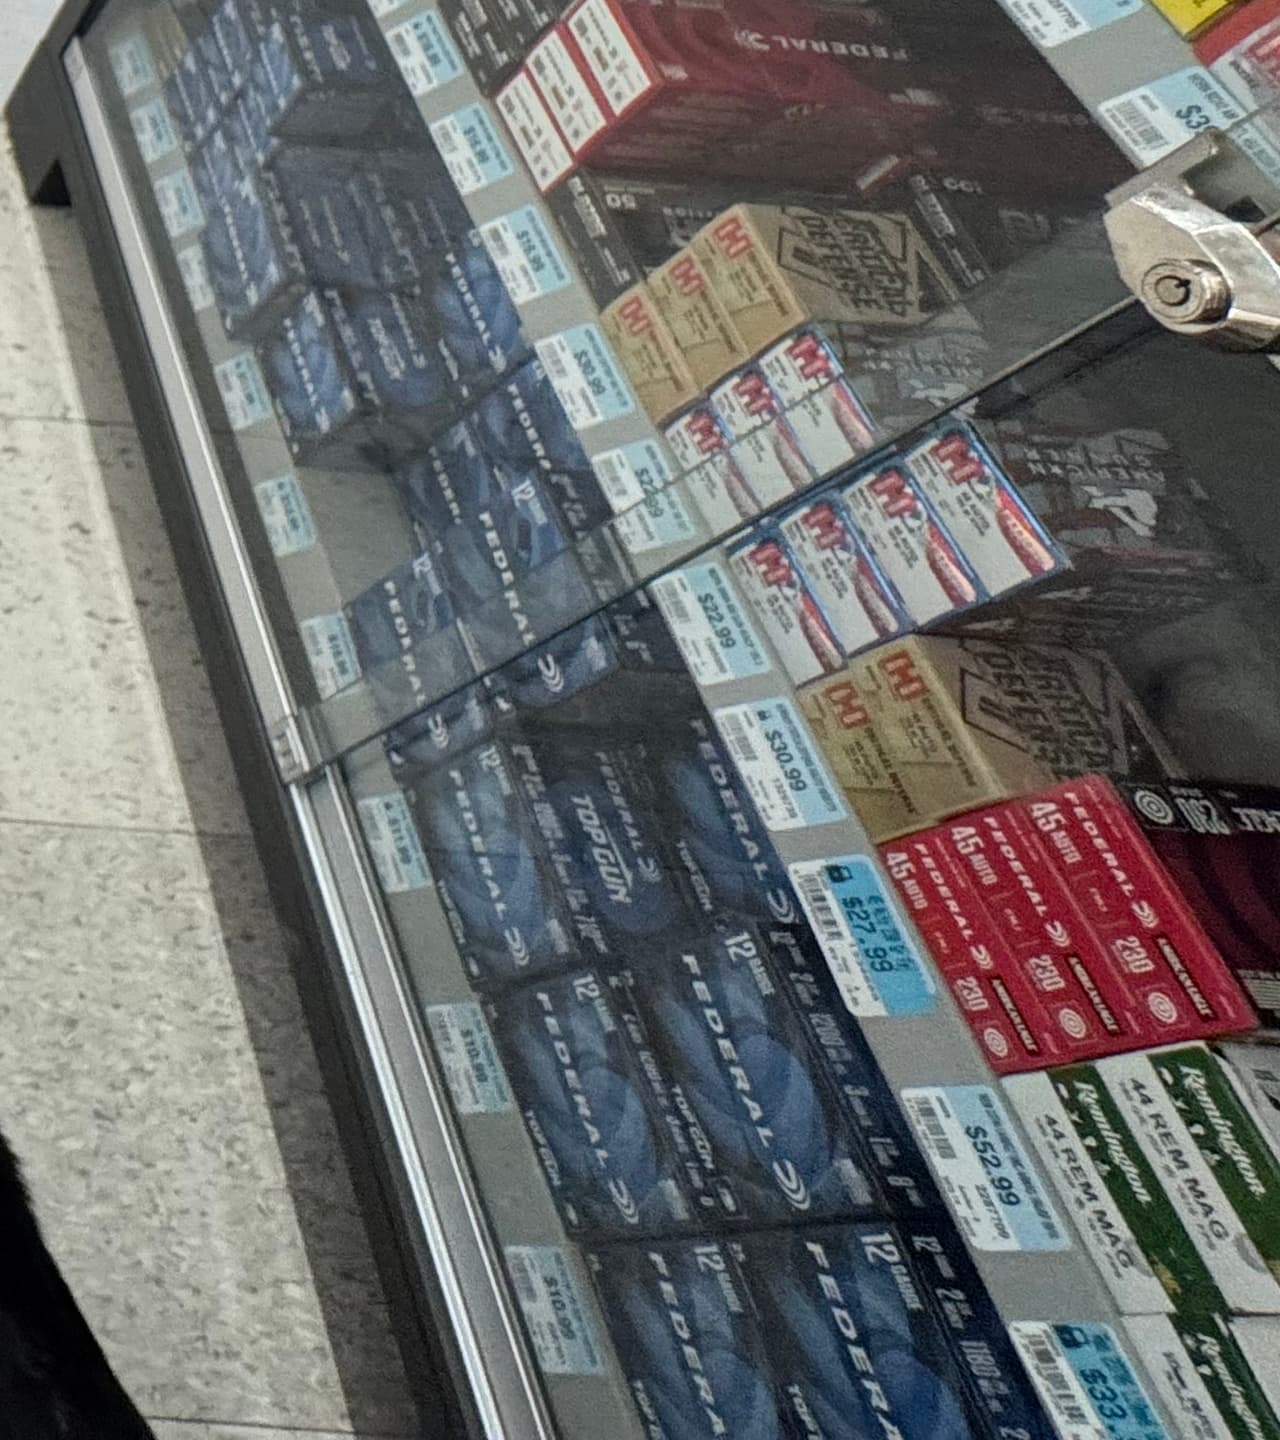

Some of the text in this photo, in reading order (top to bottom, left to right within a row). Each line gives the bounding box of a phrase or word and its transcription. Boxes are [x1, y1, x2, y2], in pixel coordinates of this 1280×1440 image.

[772, 35, 910, 61] FEDERAL
[478, 511, 537, 648] FEDERAL
[697, 592, 737, 649] $22.99
[383, 580, 427, 708] FEDERAL
[595, 751, 644, 851] FEDERAL
[691, 718, 769, 881] FEDERAL
[765, 729, 808, 792] $30.99
[449, 769, 507, 922] FEDERAL
[570, 793, 634, 905] TOP GUN
[886, 851, 917, 881] 45
[950, 825, 999, 887] 45 AUTO
[982, 815, 1049, 918] FEDERAL
[1030, 802, 1083, 865] 45 AUTO
[1063, 791, 1137, 899] FEDERAL
[841, 896, 894, 973] $27.99
[901, 878, 929, 910] AUTO
[913, 842, 975, 942] FEDERAL
[573, 974, 602, 1001] 12
[724, 931, 757, 963] 12
[955, 975, 989, 1012] 230
[1024, 953, 1067, 993] 230
[1114, 935, 1156, 974] 230
[536, 991, 609, 1169] FEDERAL
[682, 954, 775, 1149] FEDERAL
[965, 1124, 1021, 1206] $52.99
[1071, 1078, 1152, 1206] Remington
[1129, 1076, 1230, 1242] 44 REM MAG
[1177, 1063, 1267, 1198] Remington
[1044, 1112, 1136, 1270] 44 REM MAG
[694, 1244, 727, 1273] 12
[860, 1231, 902, 1264] 12
[648, 1251, 728, 1440] FEDERA
[806, 1240, 903, 1440] FEDERA
